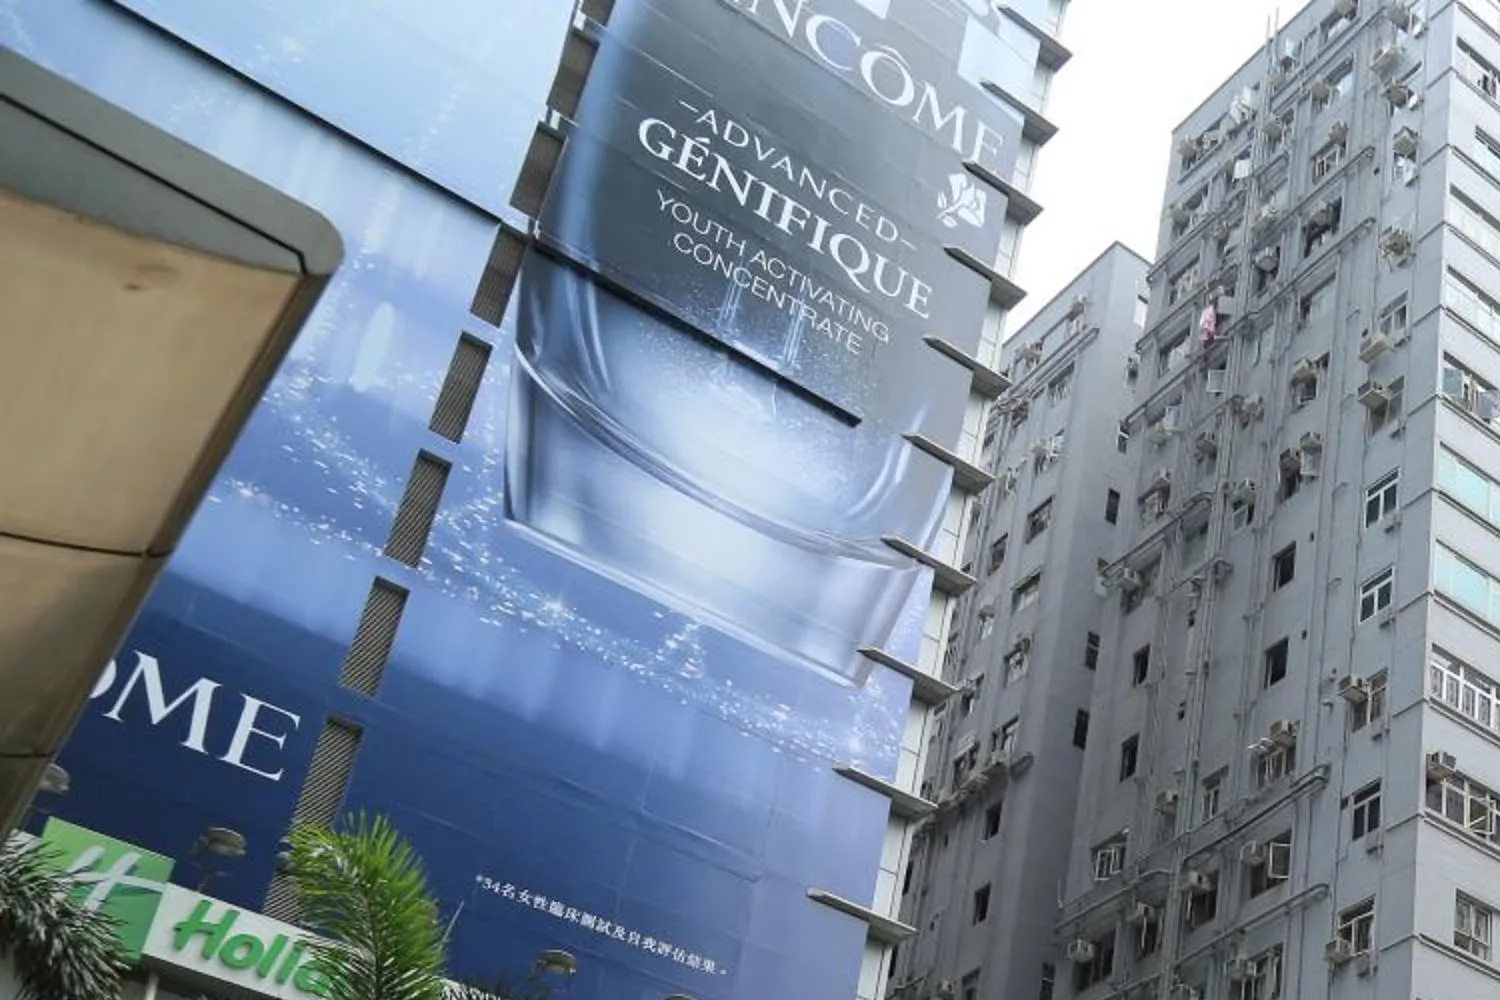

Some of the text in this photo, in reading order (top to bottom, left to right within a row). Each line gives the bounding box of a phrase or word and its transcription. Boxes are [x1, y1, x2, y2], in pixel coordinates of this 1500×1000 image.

[733, 0, 1004, 168] NCÔME
[638, 116, 932, 320] GÉNIFIQUE
[655, 189, 891, 343] YOUTH ACTIVATING
[672, 233, 864, 355] CONCENTRATE
[88, 650, 301, 782] ME
